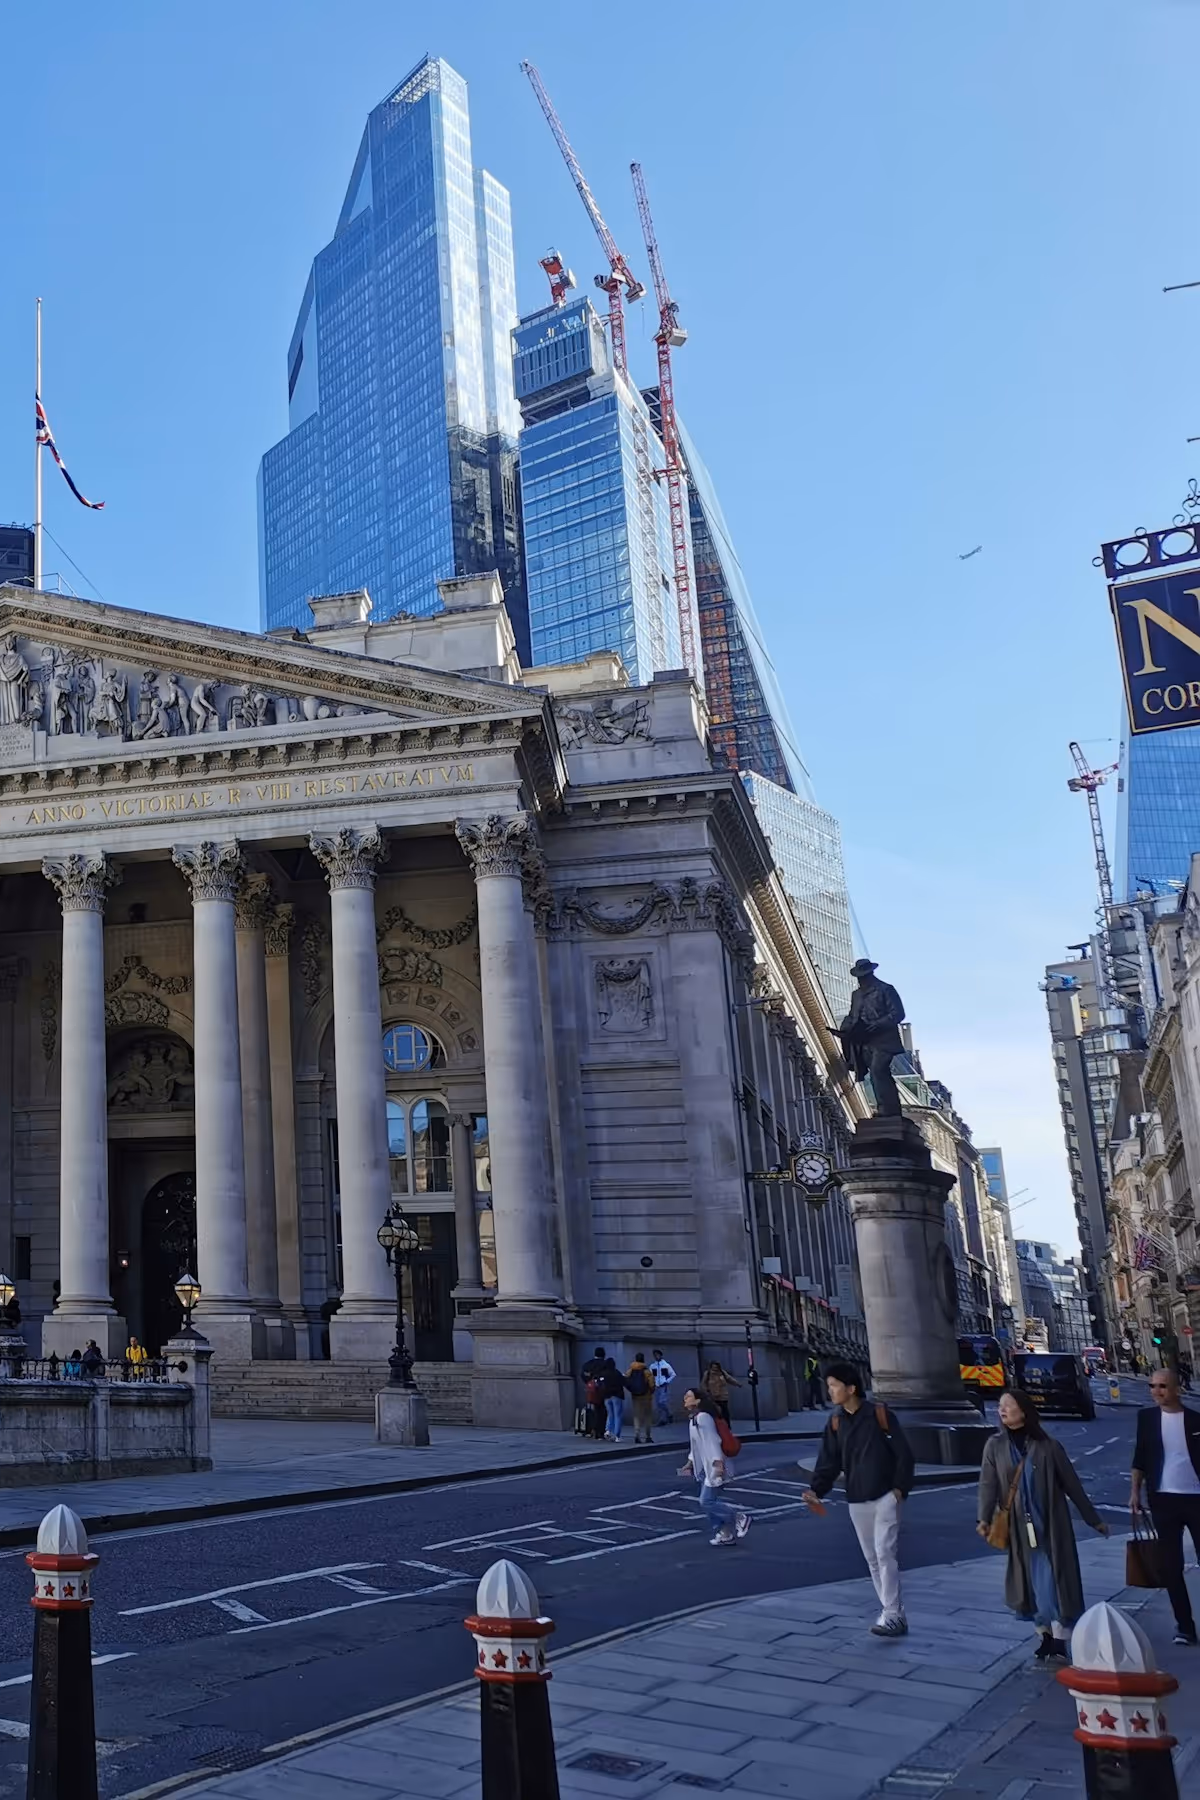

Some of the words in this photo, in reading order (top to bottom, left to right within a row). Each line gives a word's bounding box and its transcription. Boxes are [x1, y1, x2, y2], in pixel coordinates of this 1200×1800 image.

[25, 804, 86, 825] ANNO
[100, 791, 215, 818] VICTORIAE
[228, 788, 241, 804] R
[256, 783, 291, 800] VIII
[304, 763, 474, 797] RESTAVRATVM
